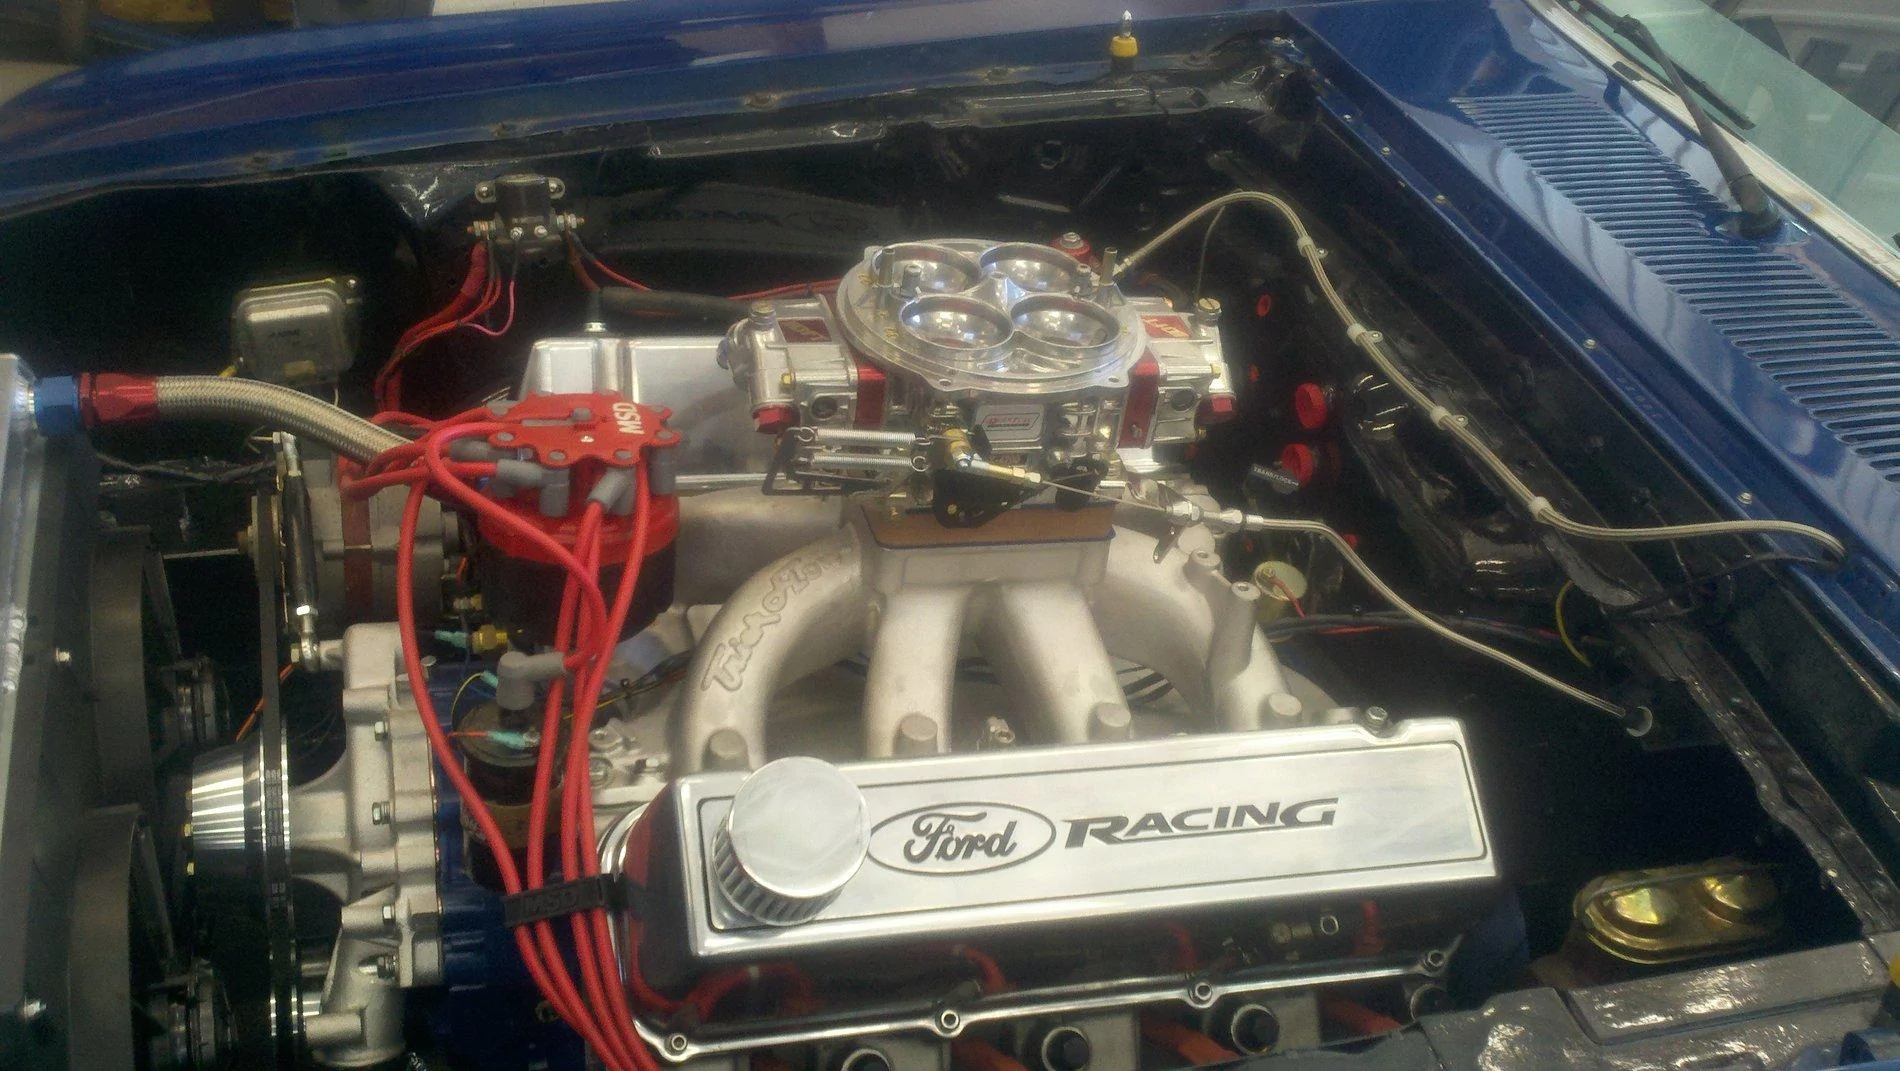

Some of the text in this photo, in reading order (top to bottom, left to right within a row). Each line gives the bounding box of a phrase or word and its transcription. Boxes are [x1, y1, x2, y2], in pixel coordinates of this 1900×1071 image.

[612, 402, 645, 435] MSD
[903, 797, 1339, 863] Ford RACING
